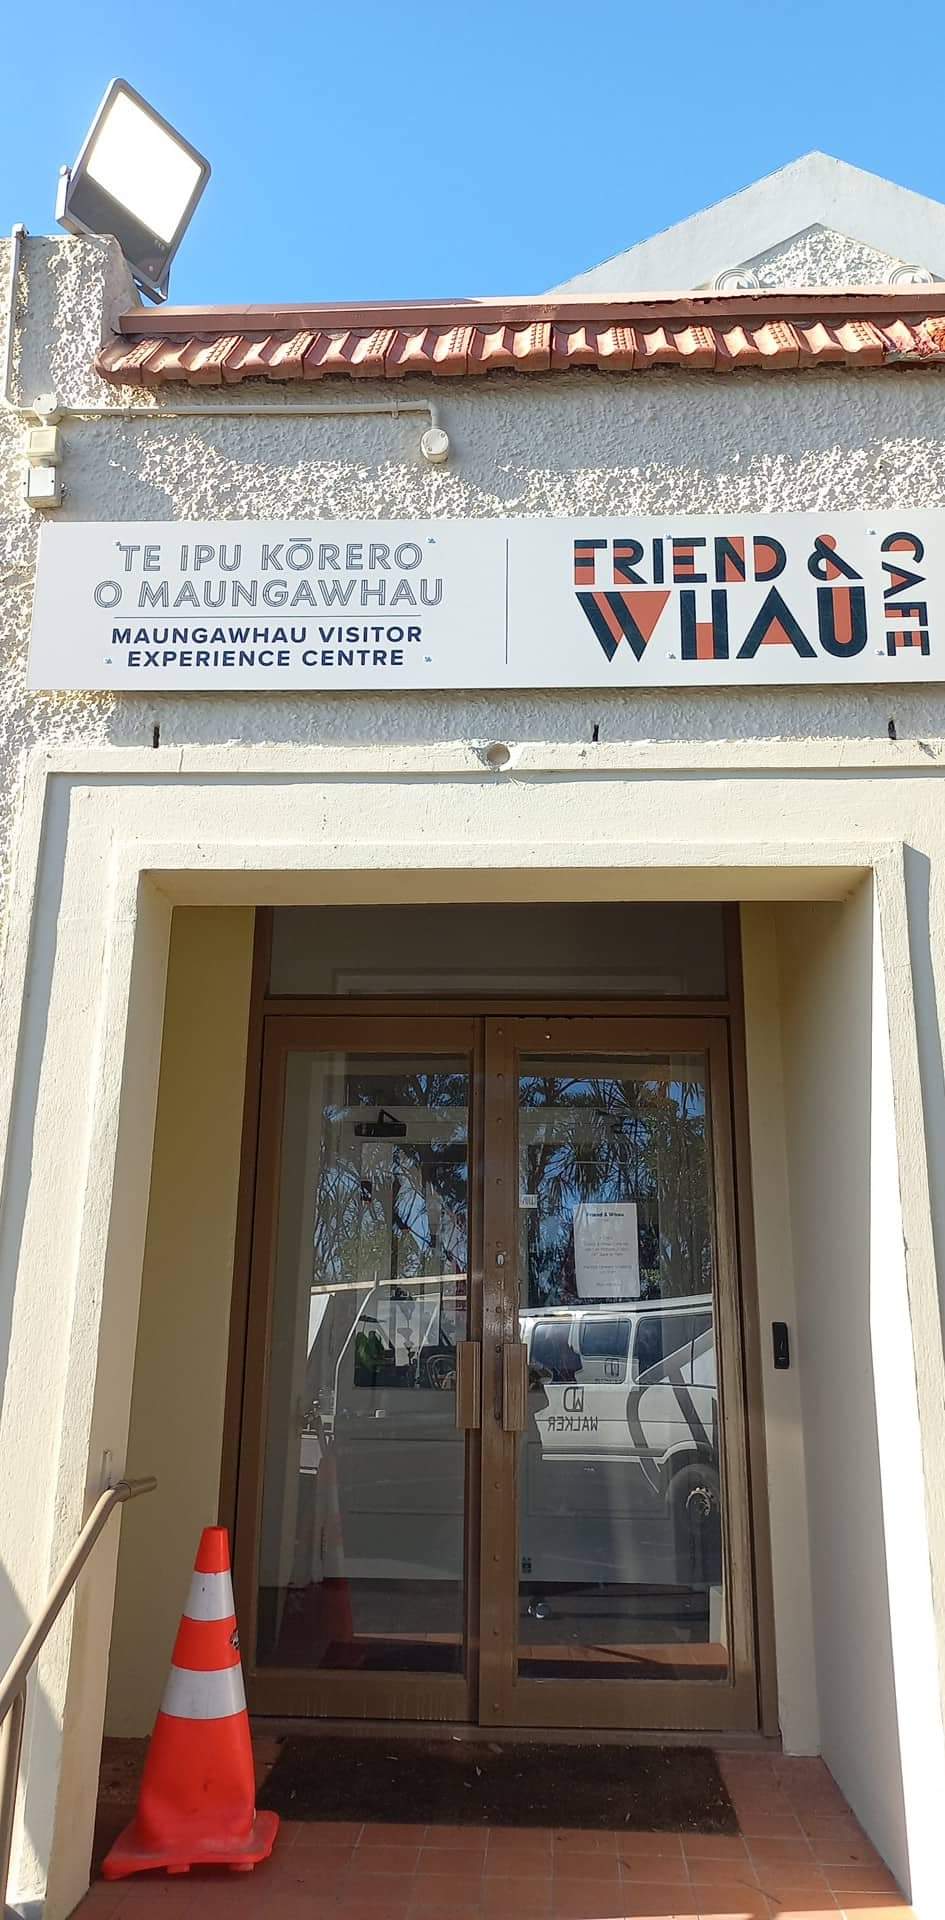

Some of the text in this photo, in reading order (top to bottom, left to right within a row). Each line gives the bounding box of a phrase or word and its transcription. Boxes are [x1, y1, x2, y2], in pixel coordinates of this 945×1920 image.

[119, 538, 423, 572] TE IPU KŌRERO
[574, 534, 863, 585] FRIEND &
[94, 578, 443, 608] O MAUNGAWHAU
[881, 531, 931, 656] CAFE
[111, 625, 422, 645] MAUNGAWHAU VISITOR
[575, 585, 868, 662] WHAU
[127, 649, 404, 667] EXPERIENCE CENTRE
